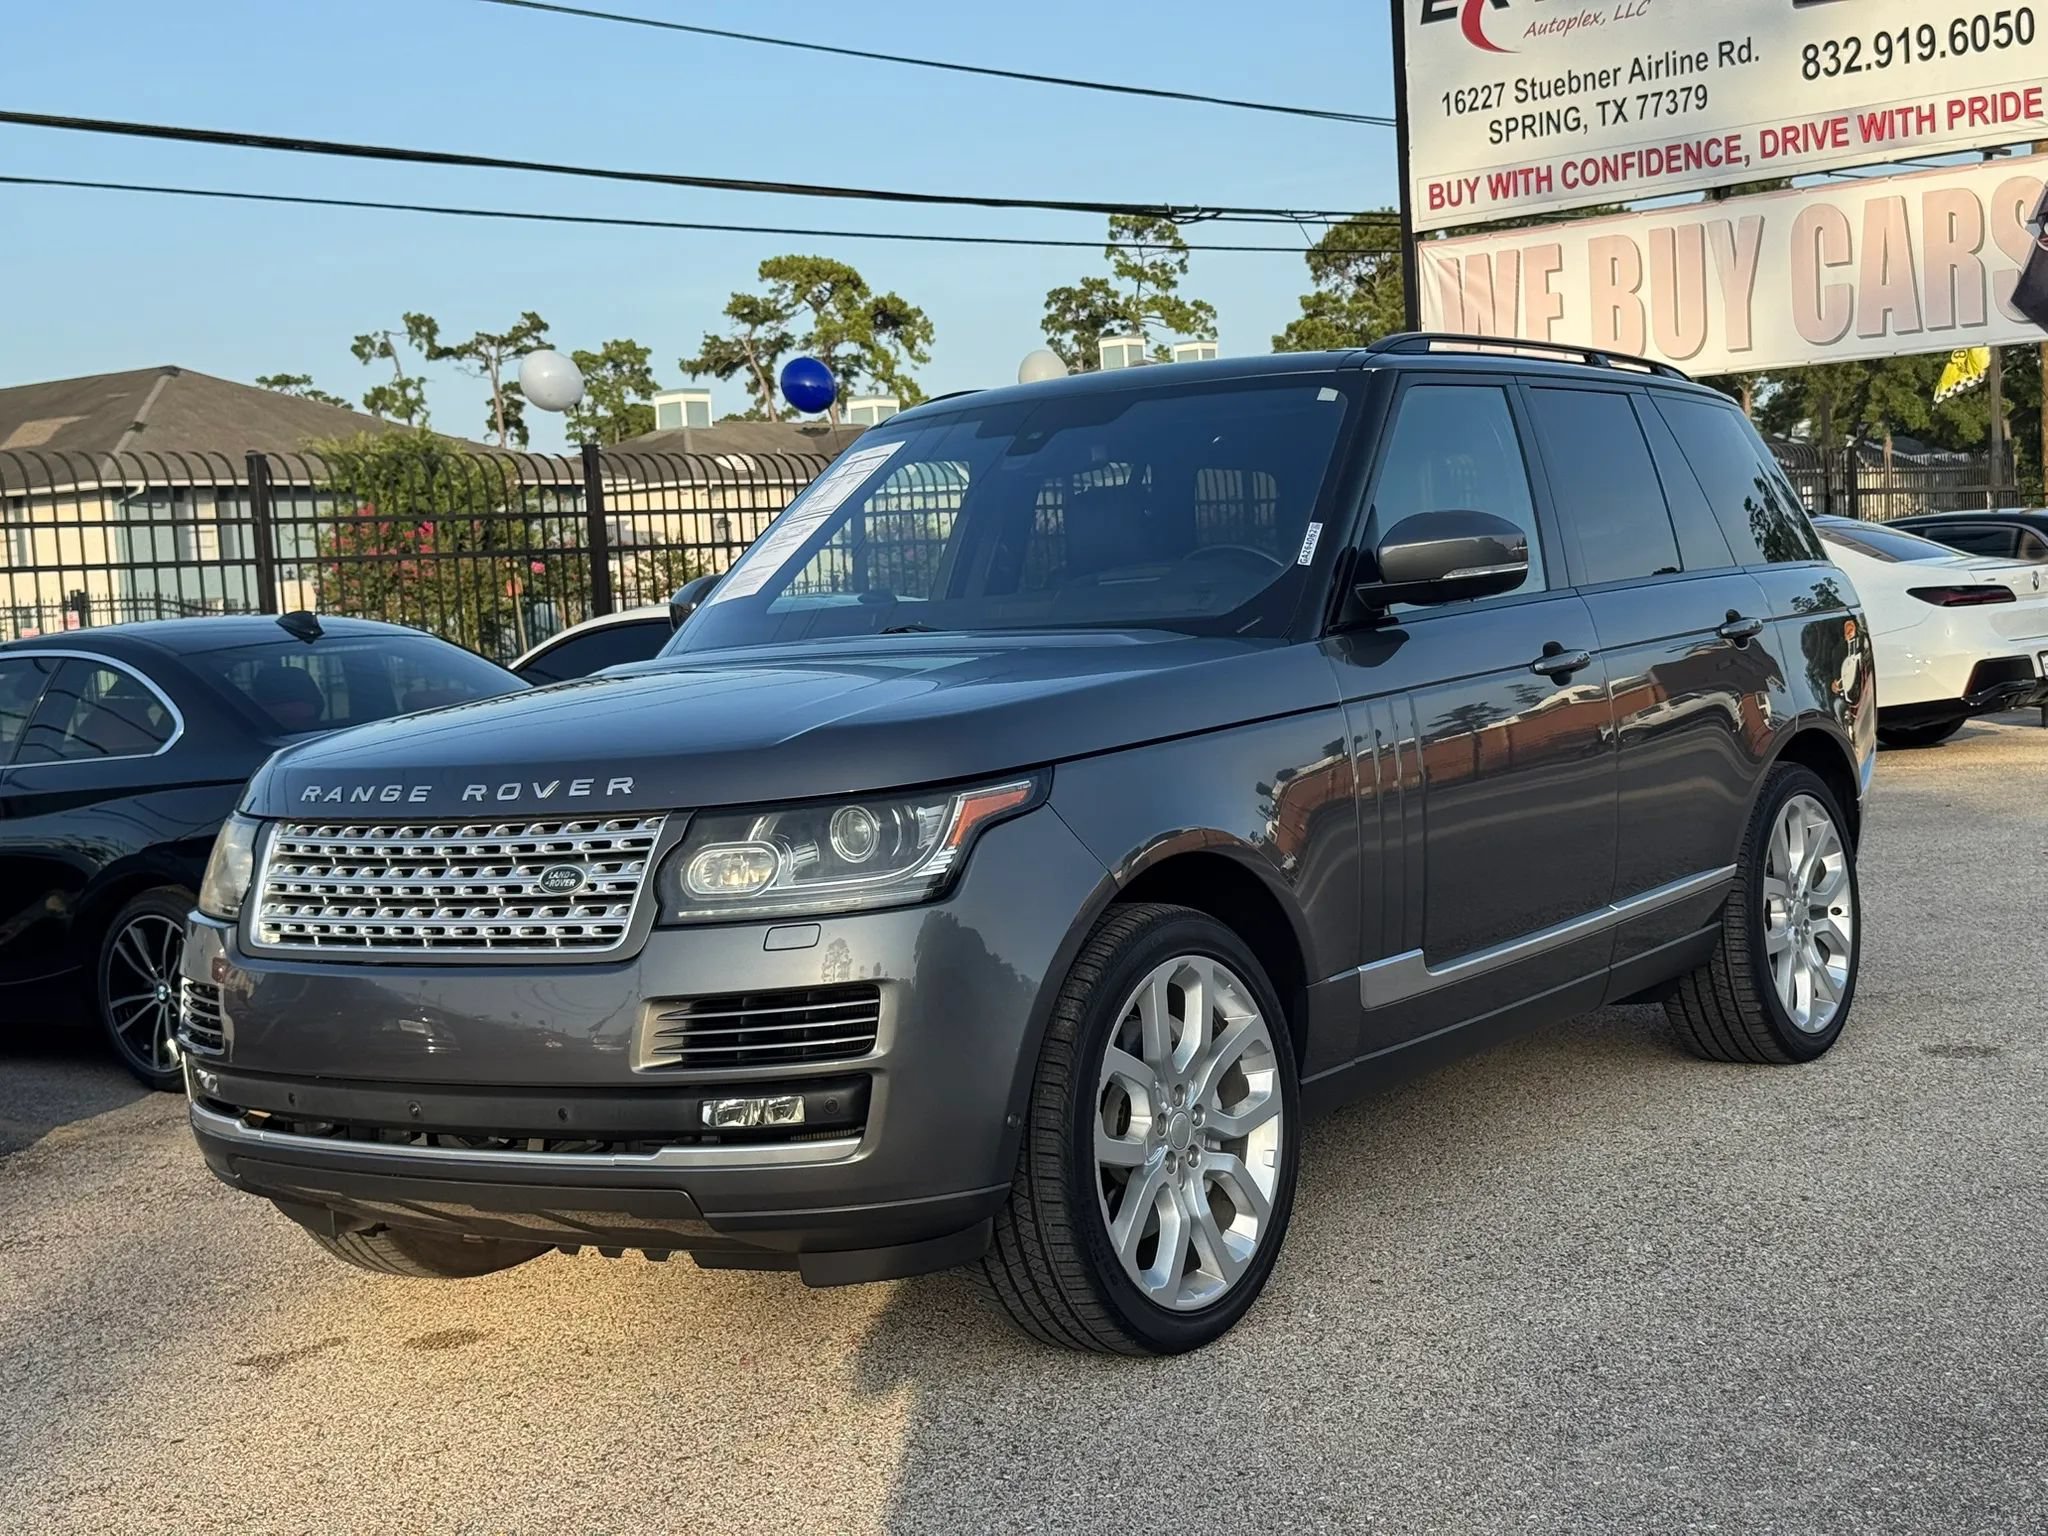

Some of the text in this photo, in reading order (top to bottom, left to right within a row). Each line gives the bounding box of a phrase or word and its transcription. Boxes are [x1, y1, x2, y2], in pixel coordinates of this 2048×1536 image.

[1523, 9, 1607, 38] Autoplex,
[1613, 0, 1649, 21] LLC
[1801, 7, 2035, 80] 832.919.6050
[1441, 36, 1760, 116] 16227 Stuebner Airline Rd.
[1489, 84, 1708, 145] SPRING, TX 77379
[1428, 87, 2044, 210] BUY WITH CONFIDENCE, DRIVE WITH PRIDE
[1588, 215, 1765, 360] BUY
[1790, 176, 2045, 346] CARS
[300, 777, 635, 803] RANGE ROVER
[548, 879, 576, 887] ROVER
